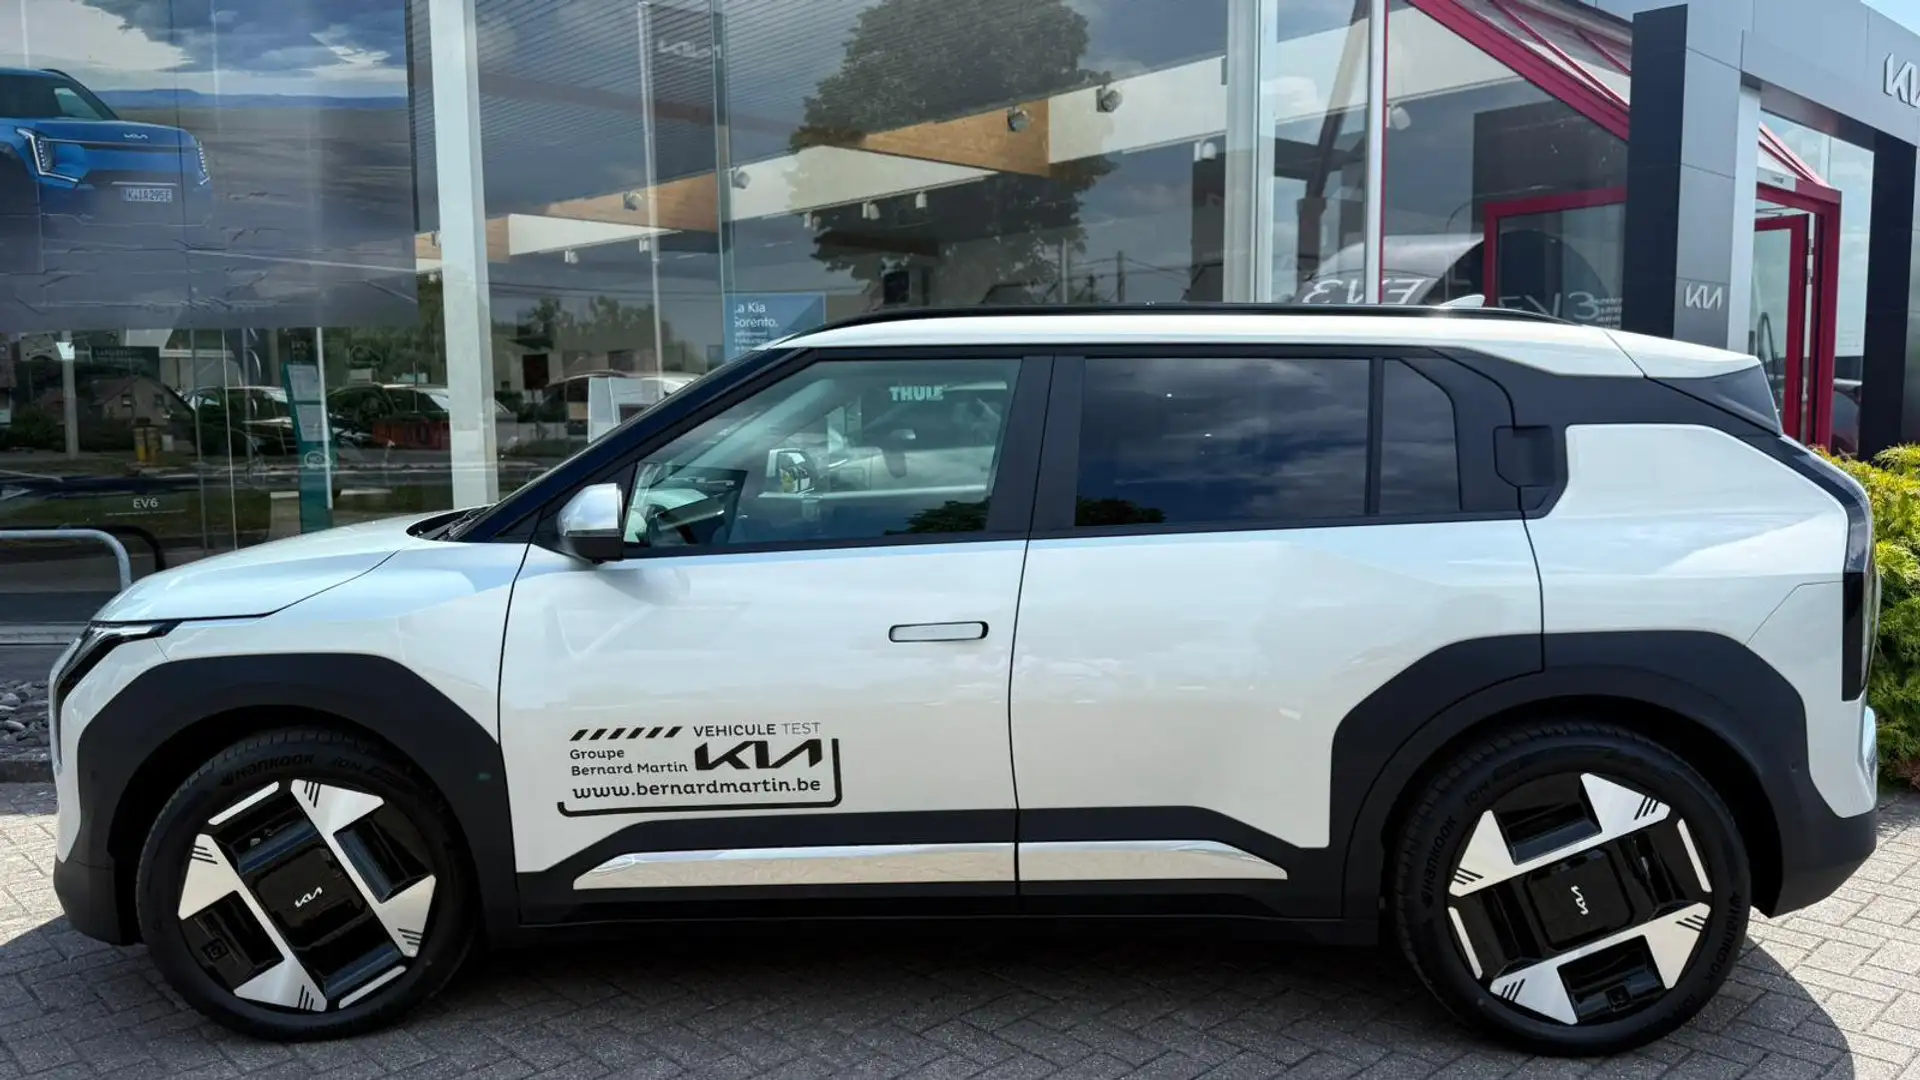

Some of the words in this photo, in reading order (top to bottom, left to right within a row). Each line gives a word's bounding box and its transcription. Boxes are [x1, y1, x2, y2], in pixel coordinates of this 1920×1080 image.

[1685, 282, 1723, 310] KIA
[747, 302, 766, 313] Kia
[889, 385, 944, 401] THULE
[132, 498, 159, 509] EV6
[693, 724, 777, 738] VEHICULE
[781, 722, 821, 736] TEST
[569, 749, 625, 761] Groupe
[694, 738, 823, 771] KIA
[571, 764, 633, 777] Bernard
[637, 762, 689, 774] Martin
[573, 778, 822, 800] www.bernardmartin.be
[294, 886, 323, 908] KIA
[1570, 885, 1589, 915] KIA
